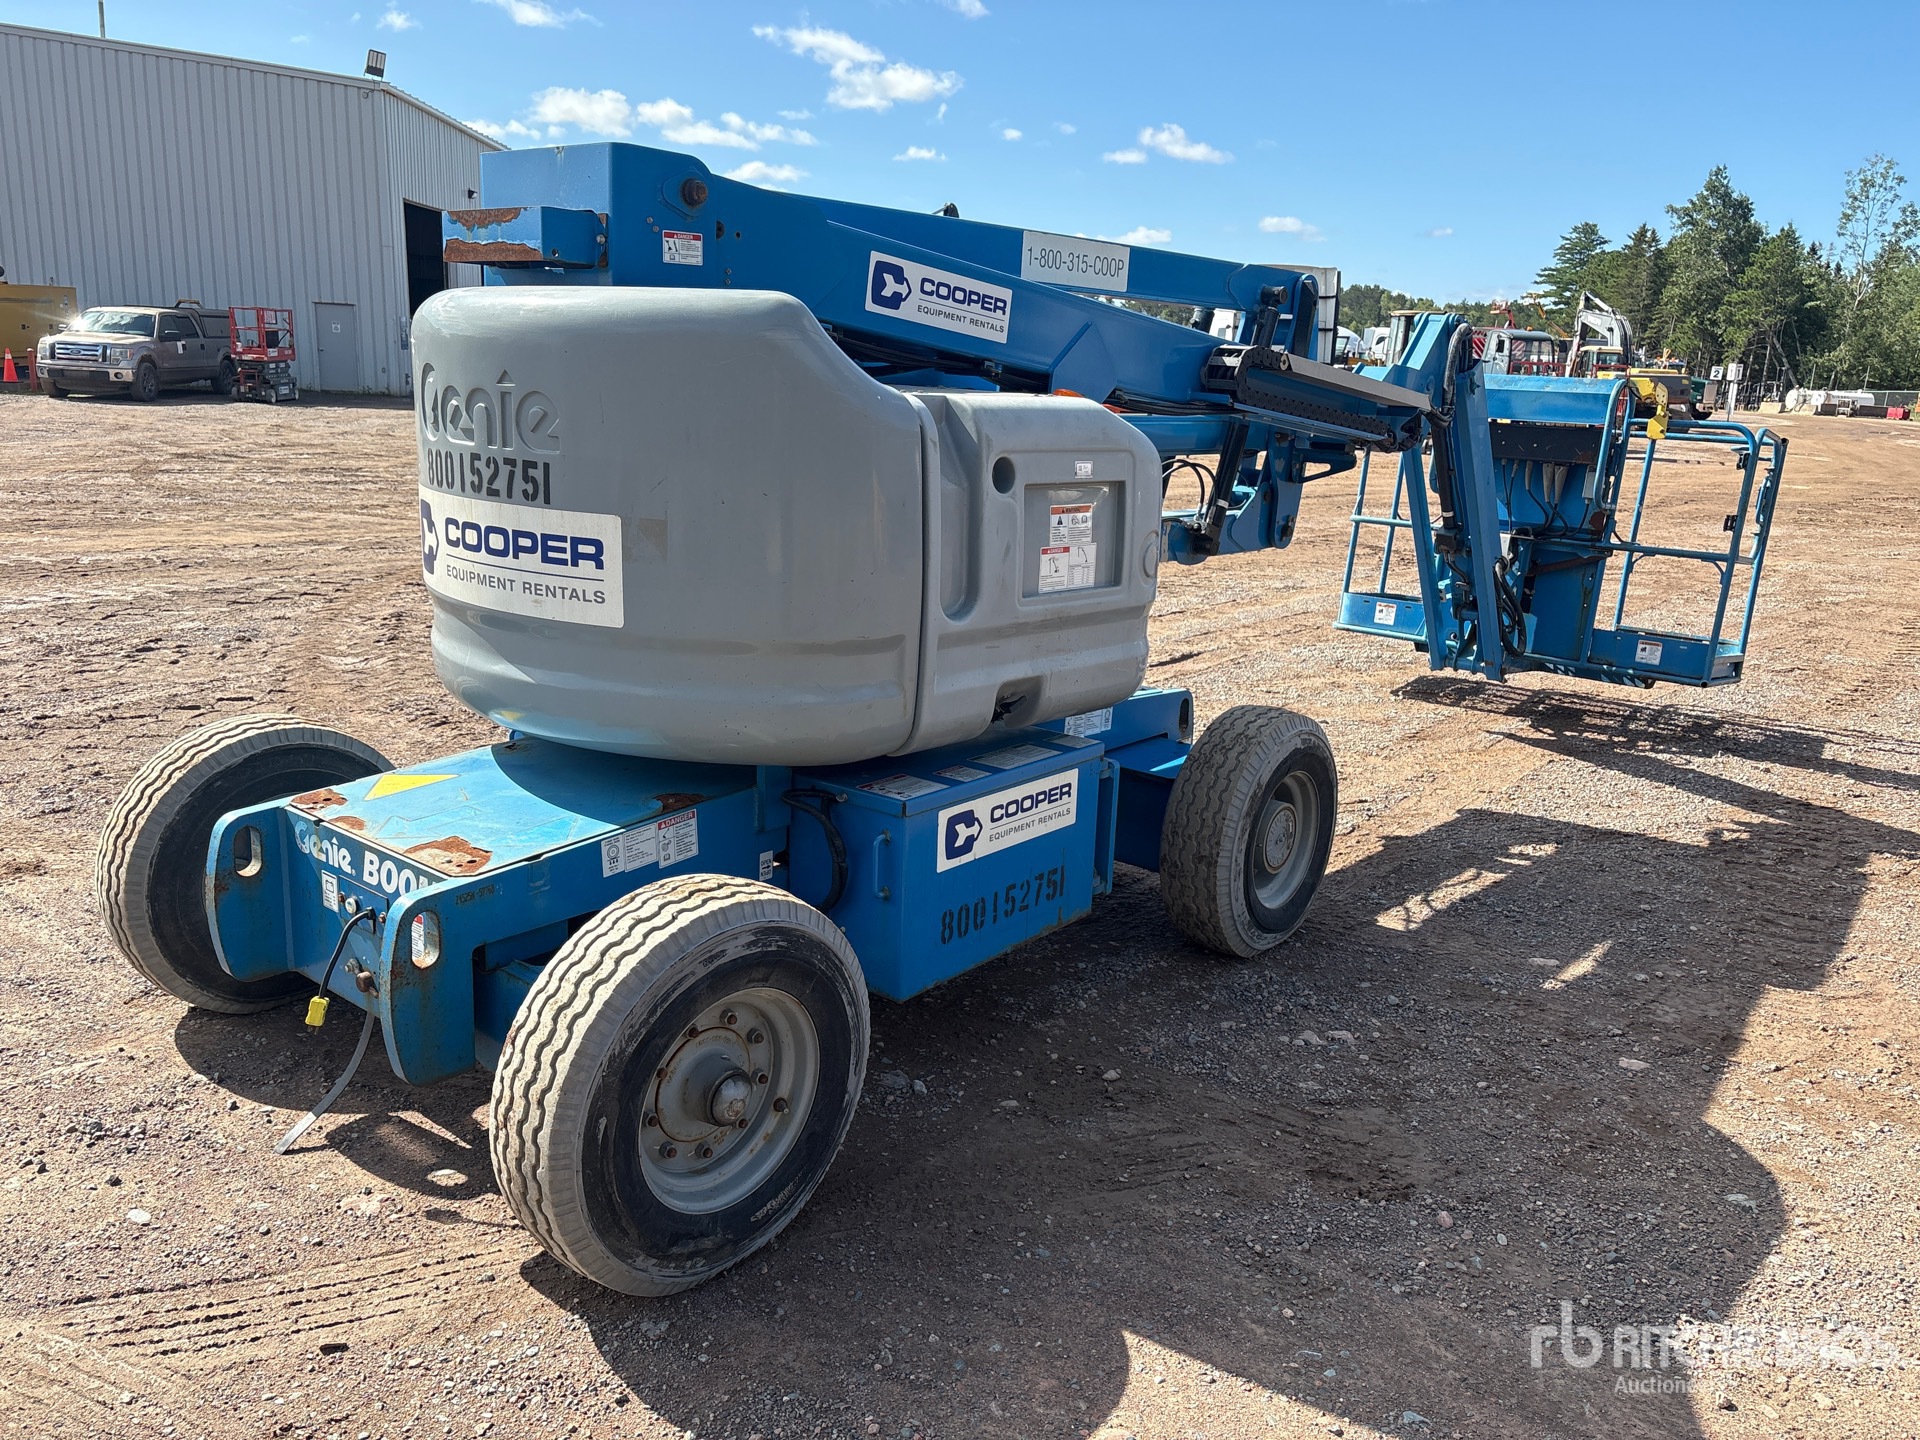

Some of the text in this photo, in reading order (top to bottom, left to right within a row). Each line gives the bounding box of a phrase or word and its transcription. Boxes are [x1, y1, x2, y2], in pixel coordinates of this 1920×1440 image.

[1026, 246, 1125, 278] 1-800-315-COOP
[919, 277, 1007, 315] COOPER
[917, 304, 1005, 333] EQUIPMENT RENTALS
[1713, 370, 1720, 378] 2
[421, 362, 561, 454] Genie
[427, 448, 550, 505] 800152751
[445, 517, 604, 570] COOPER
[446, 564, 606, 604] EQUIPMENT RENTALS
[665, 812, 693, 827] DANGER
[990, 782, 1072, 824] COOPER
[989, 807, 1071, 842] EQUIPMENT RENTALS
[941, 865, 1066, 945] 800152751
